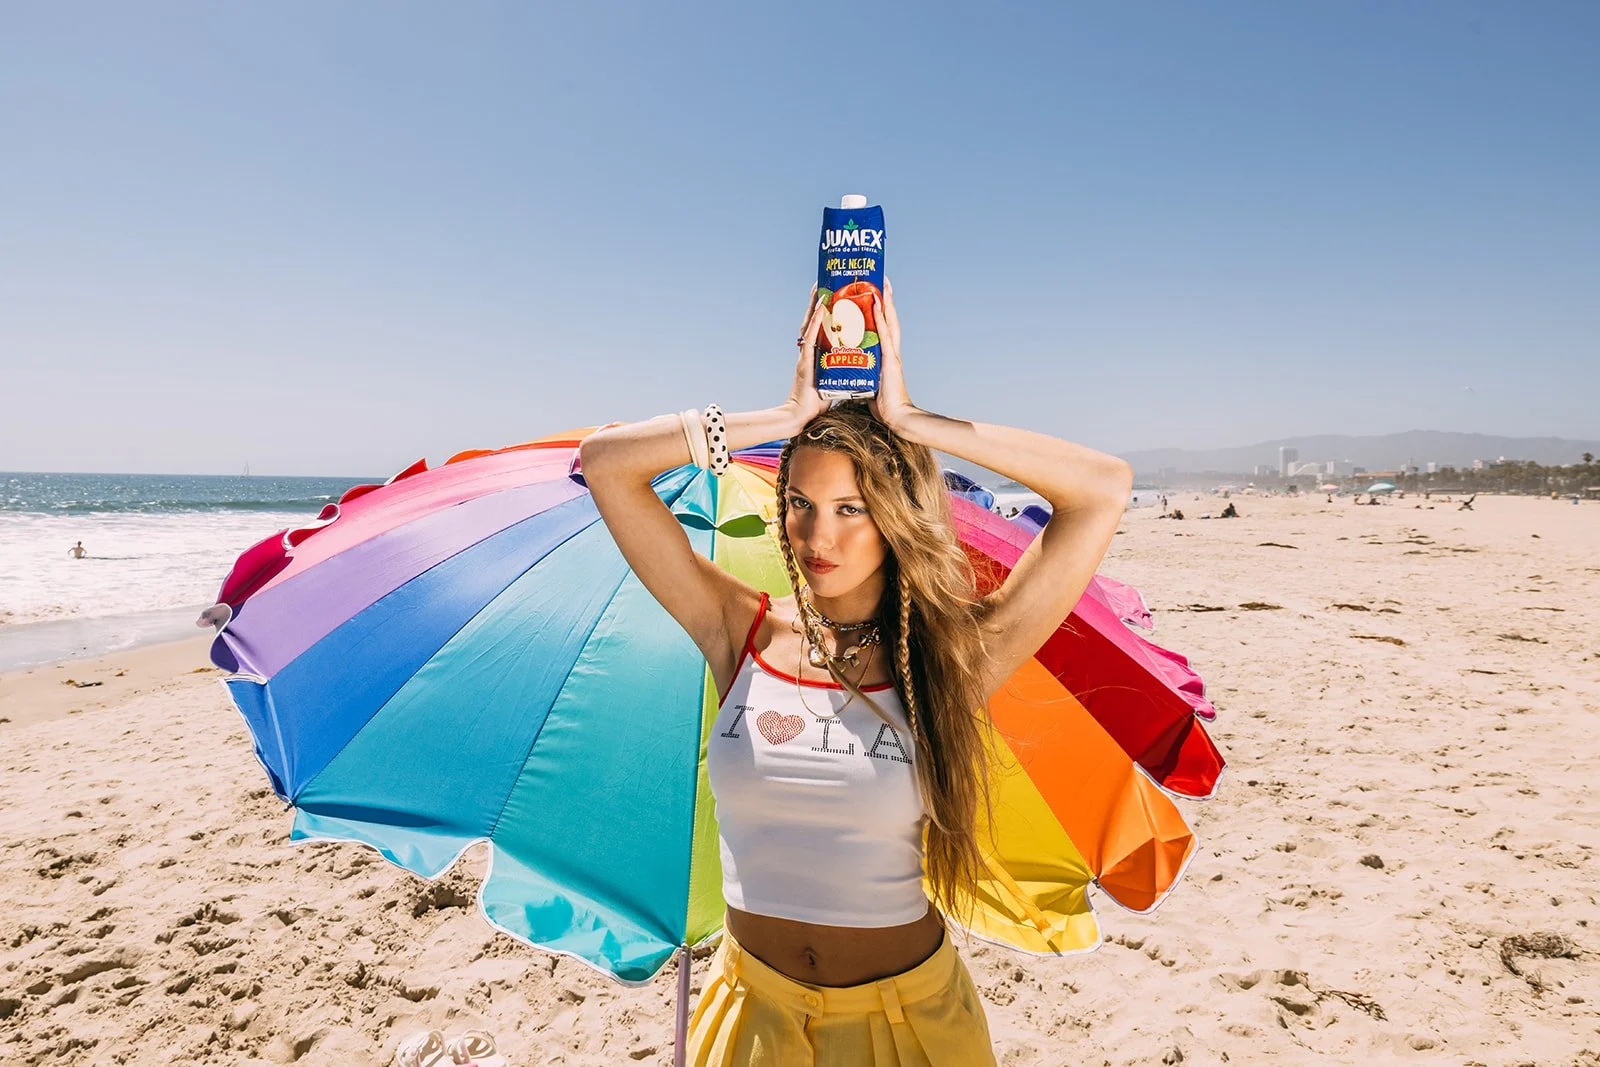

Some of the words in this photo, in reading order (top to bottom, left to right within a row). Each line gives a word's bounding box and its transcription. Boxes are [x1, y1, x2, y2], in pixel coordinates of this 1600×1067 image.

[822, 229, 883, 250] JUMEX
[826, 258, 846, 271] APPLE
[848, 258, 876, 271] NECTAR
[830, 356, 864, 365] APPLES
[721, 705, 754, 739] I
